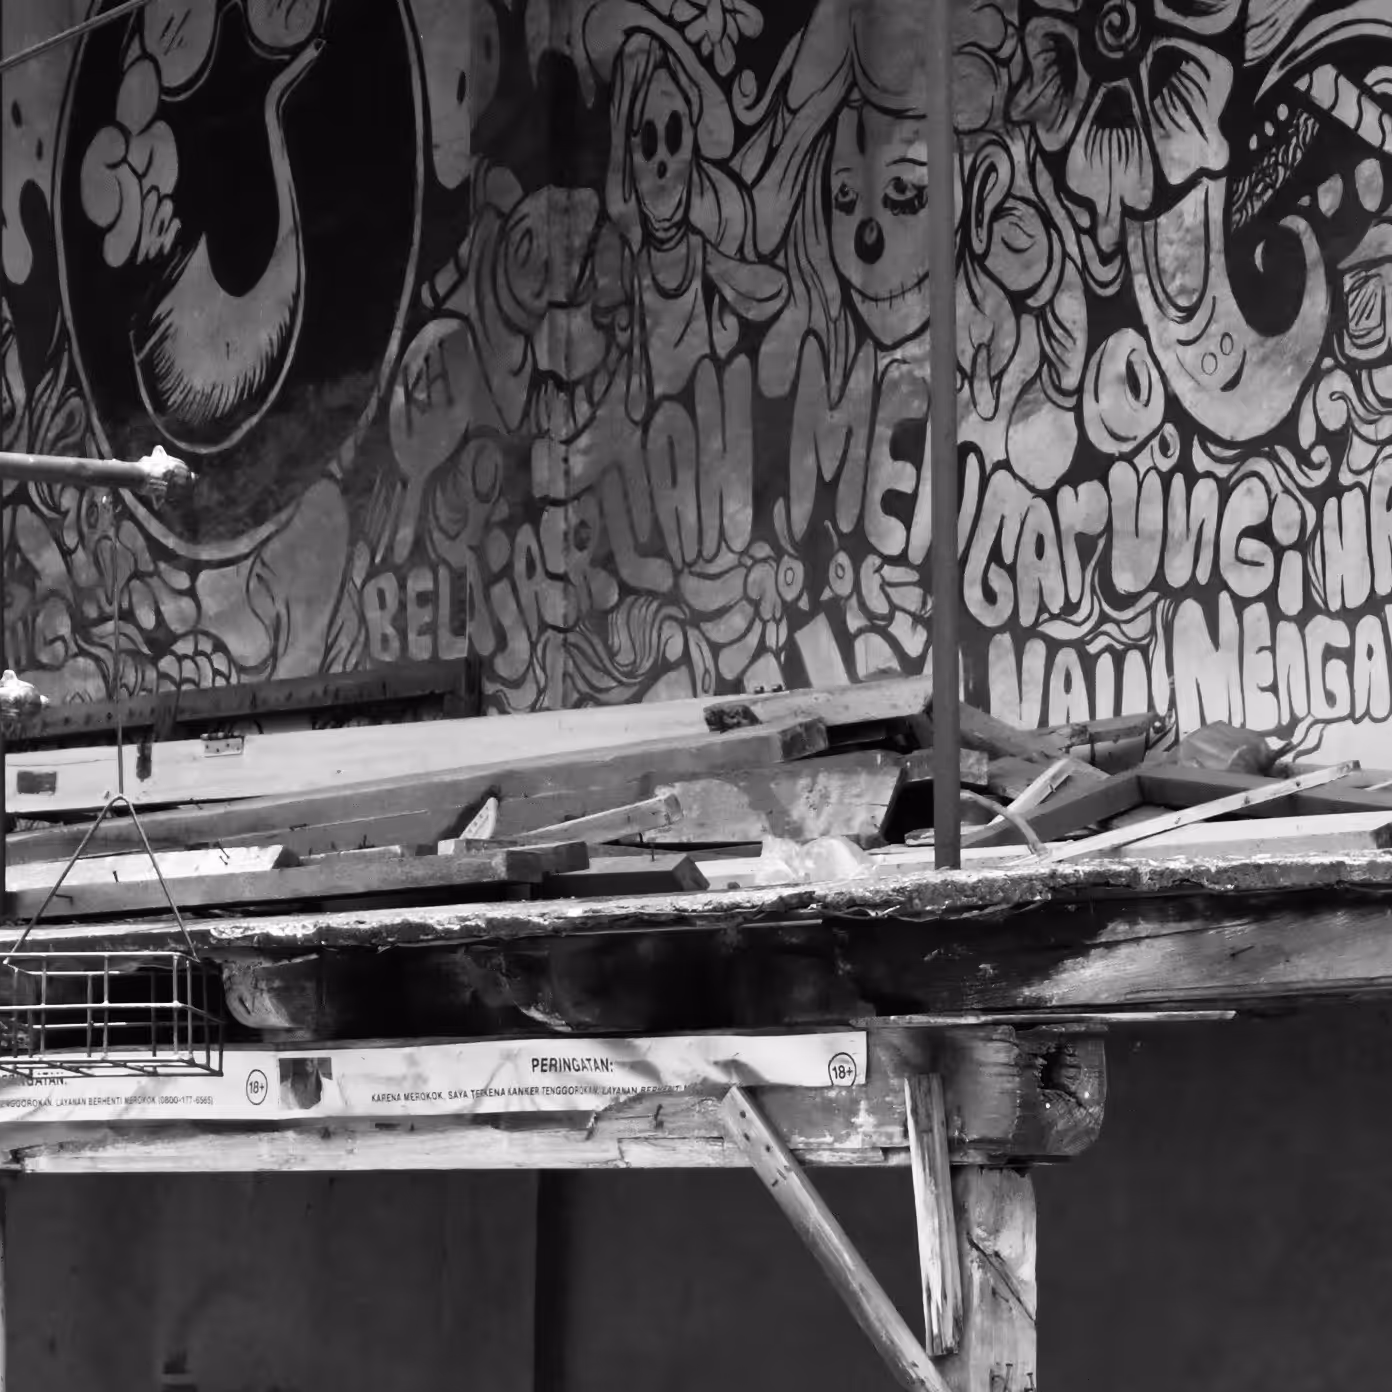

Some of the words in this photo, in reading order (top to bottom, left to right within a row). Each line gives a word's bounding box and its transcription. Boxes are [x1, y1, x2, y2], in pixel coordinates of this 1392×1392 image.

[531, 1057, 614, 1073] PERINGATAN:
[831, 1064, 854, 1080] 18+
[248, 1080, 265, 1094] 18+
[371, 1092, 402, 1103] KARENA
[448, 1089, 469, 1100] SAYA
